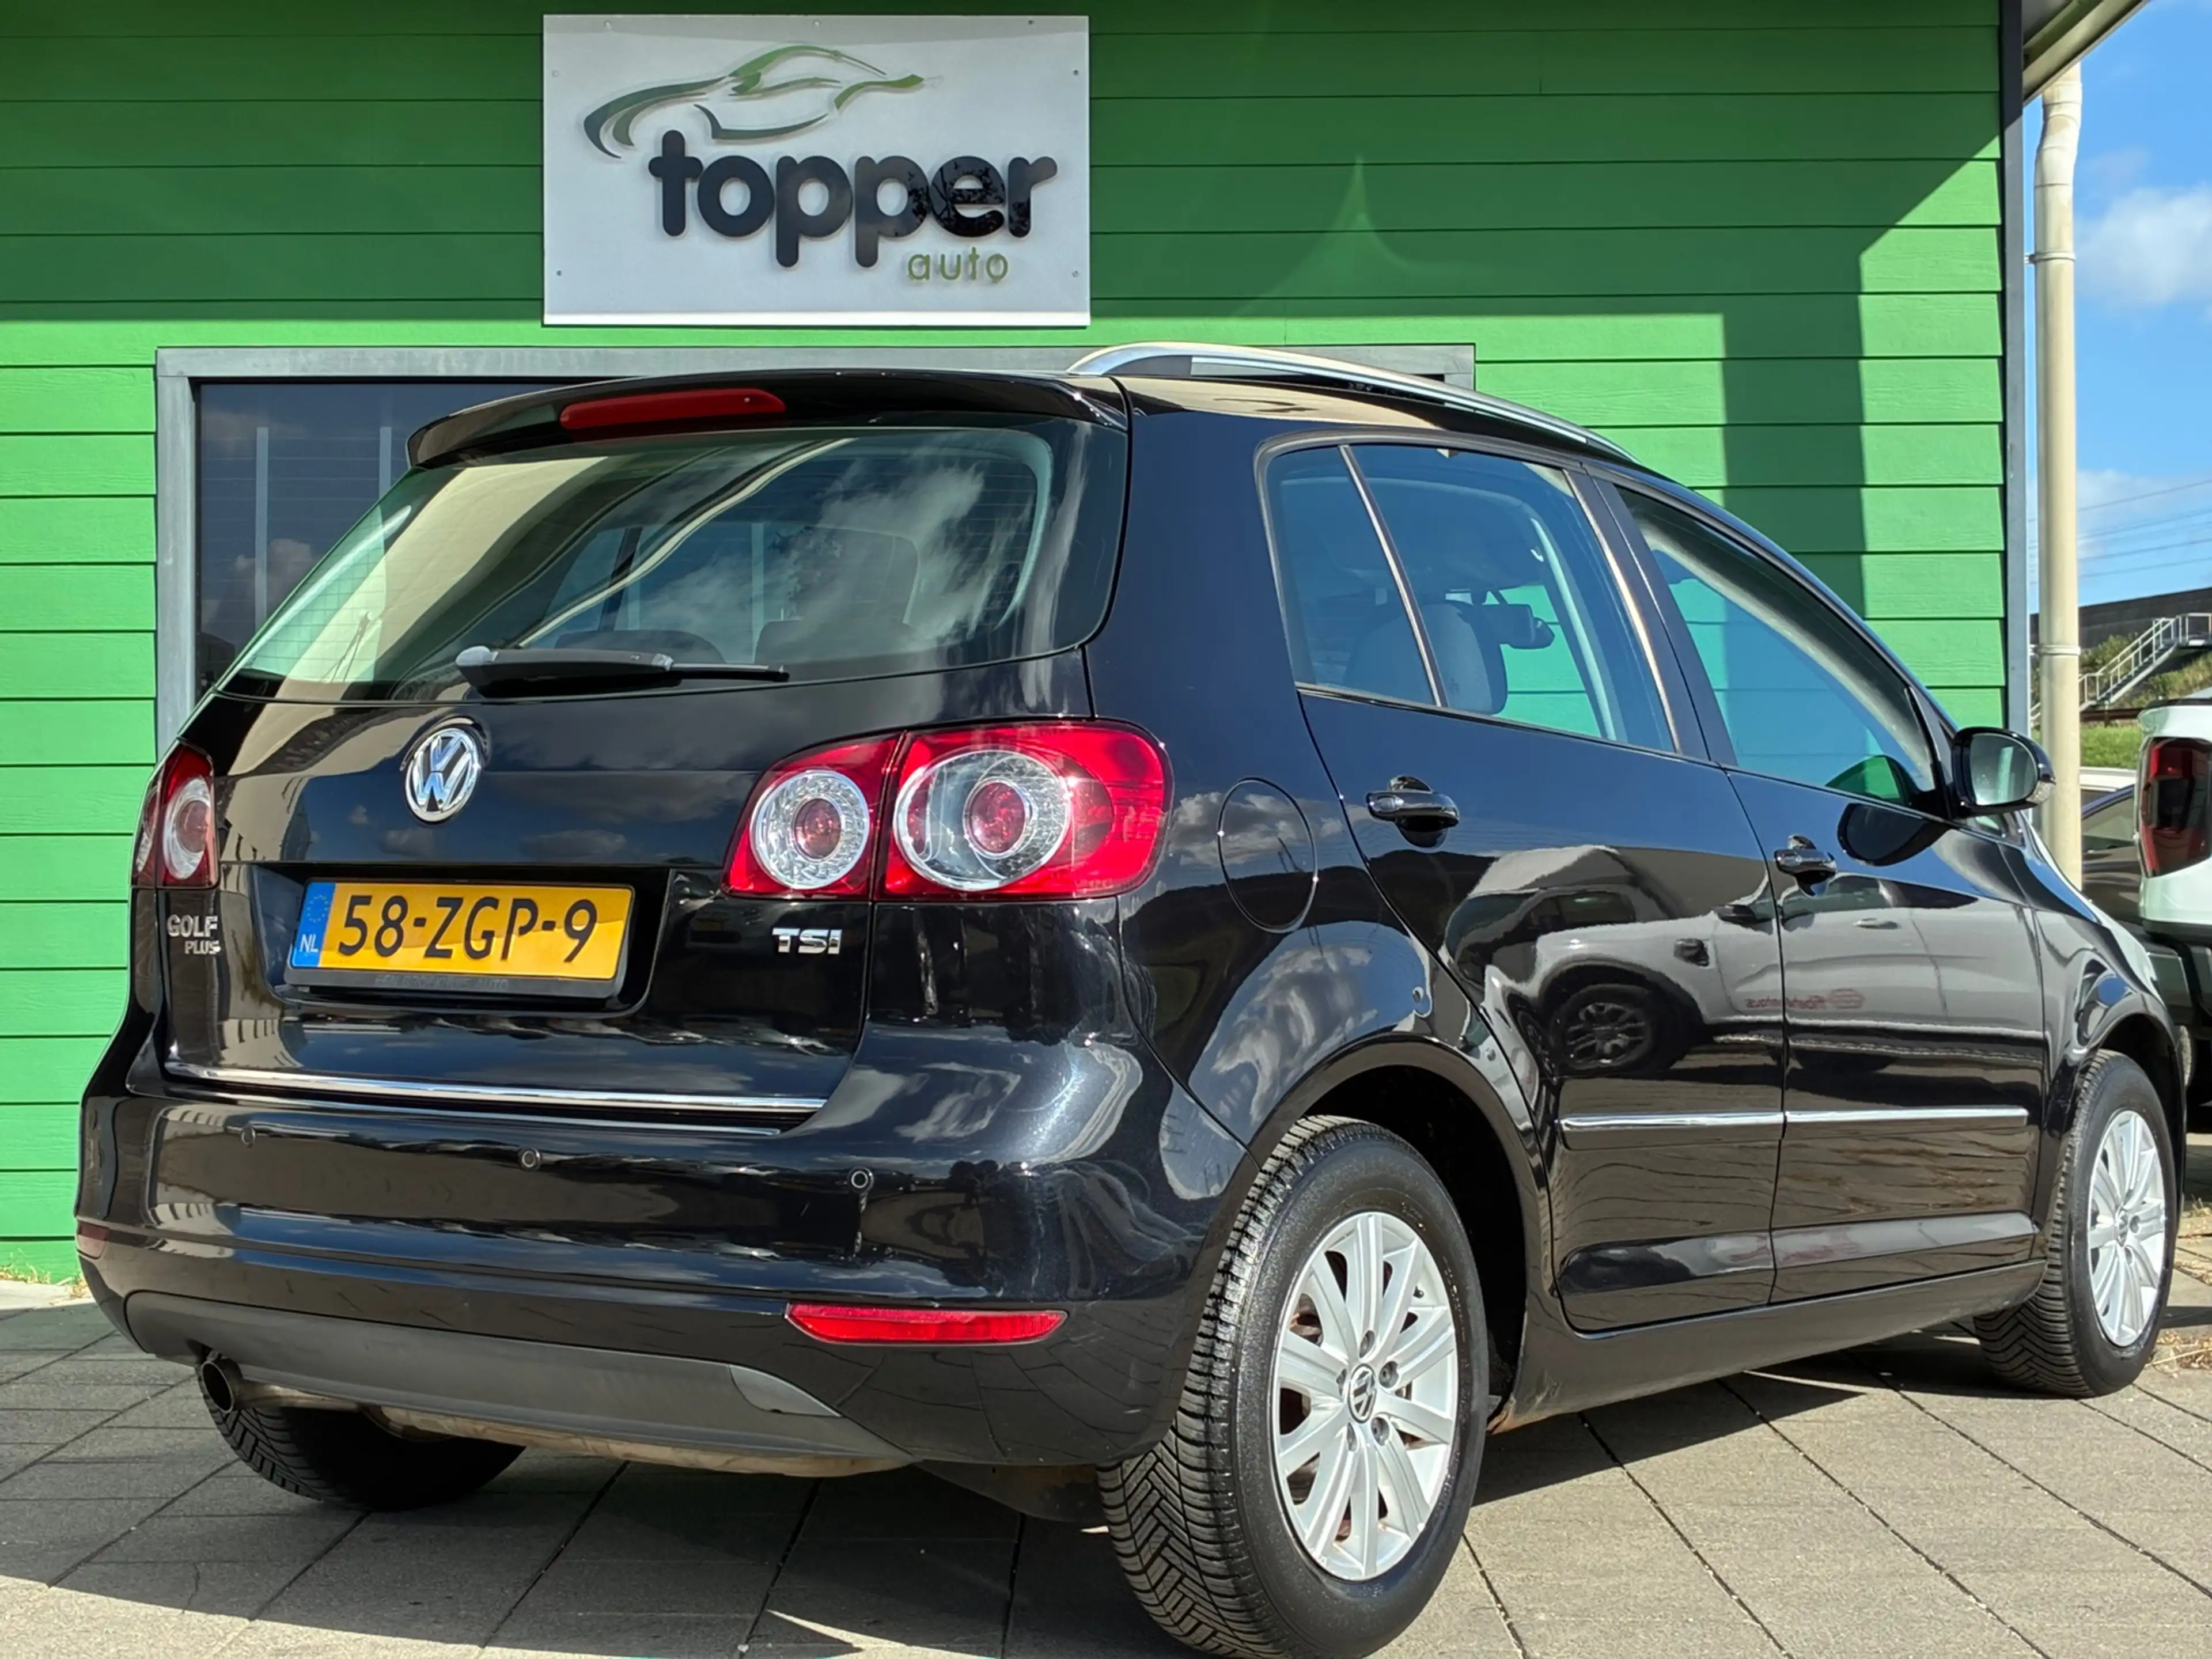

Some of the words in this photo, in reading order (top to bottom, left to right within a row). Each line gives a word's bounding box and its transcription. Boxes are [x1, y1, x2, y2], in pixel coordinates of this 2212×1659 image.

[648, 130, 1058, 268] topper
[907, 247, 1009, 282] auto
[167, 914, 218, 938] GOLF
[338, 895, 598, 963] 58-ZGP-9
[185, 940, 221, 955] PLUS
[300, 934, 319, 953] NL
[771, 927, 843, 955] TSI
